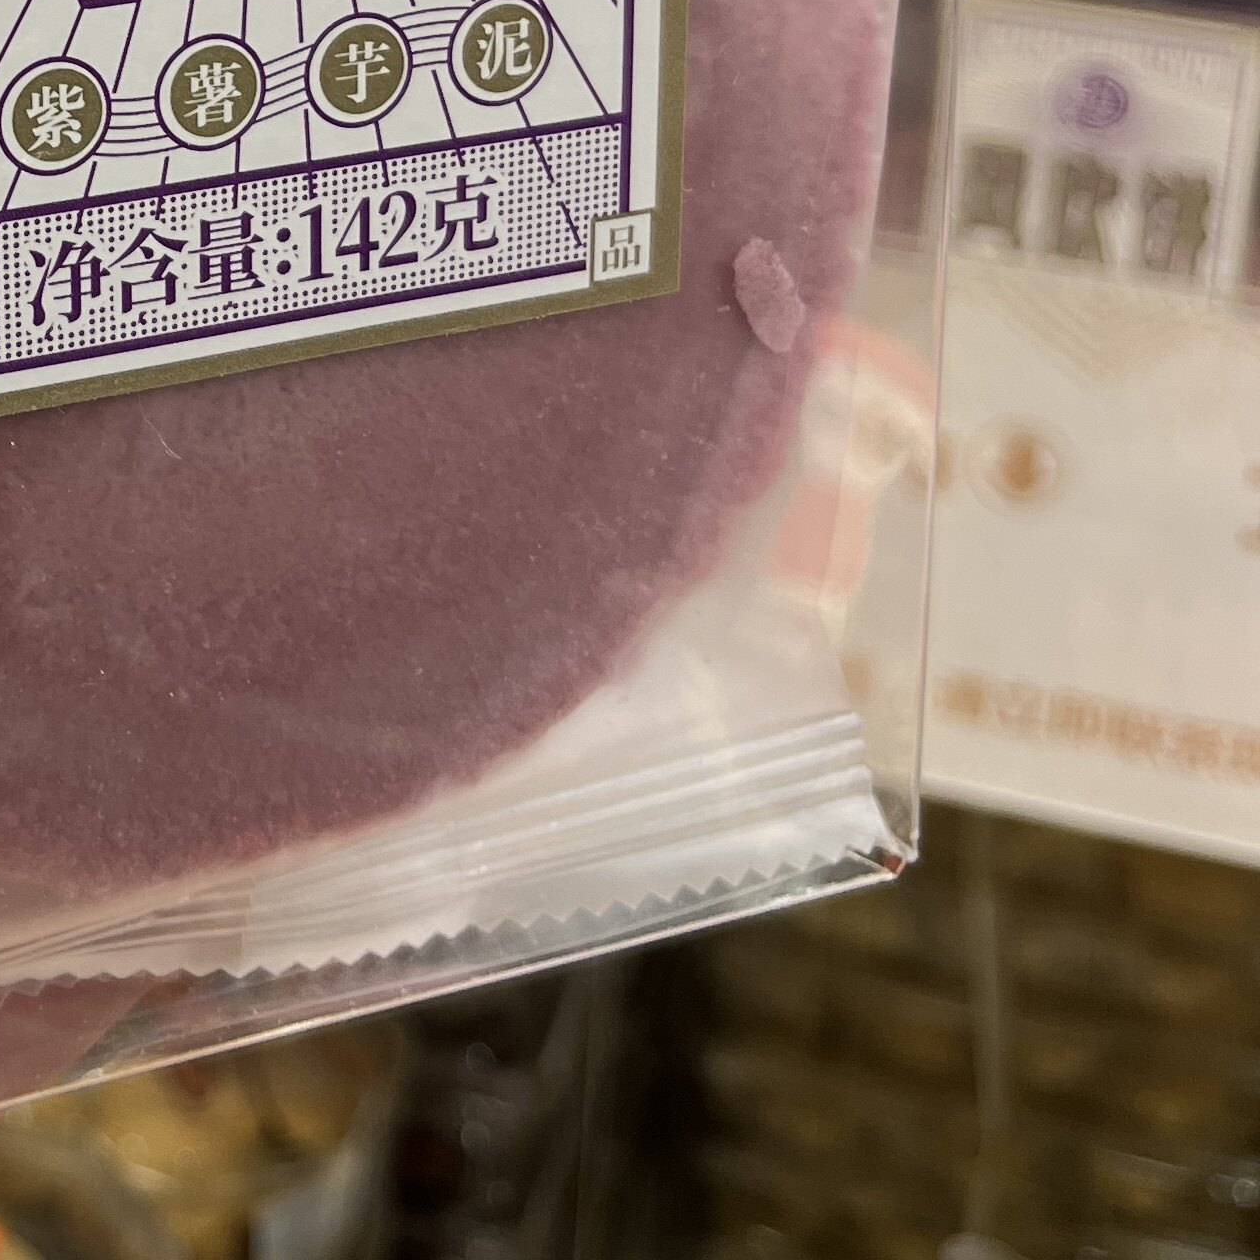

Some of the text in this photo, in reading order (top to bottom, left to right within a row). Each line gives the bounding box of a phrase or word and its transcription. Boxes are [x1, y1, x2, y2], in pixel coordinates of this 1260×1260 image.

[24, 20, 536, 153] 紫薯芋泥
[601, 223, 643, 272] 品
